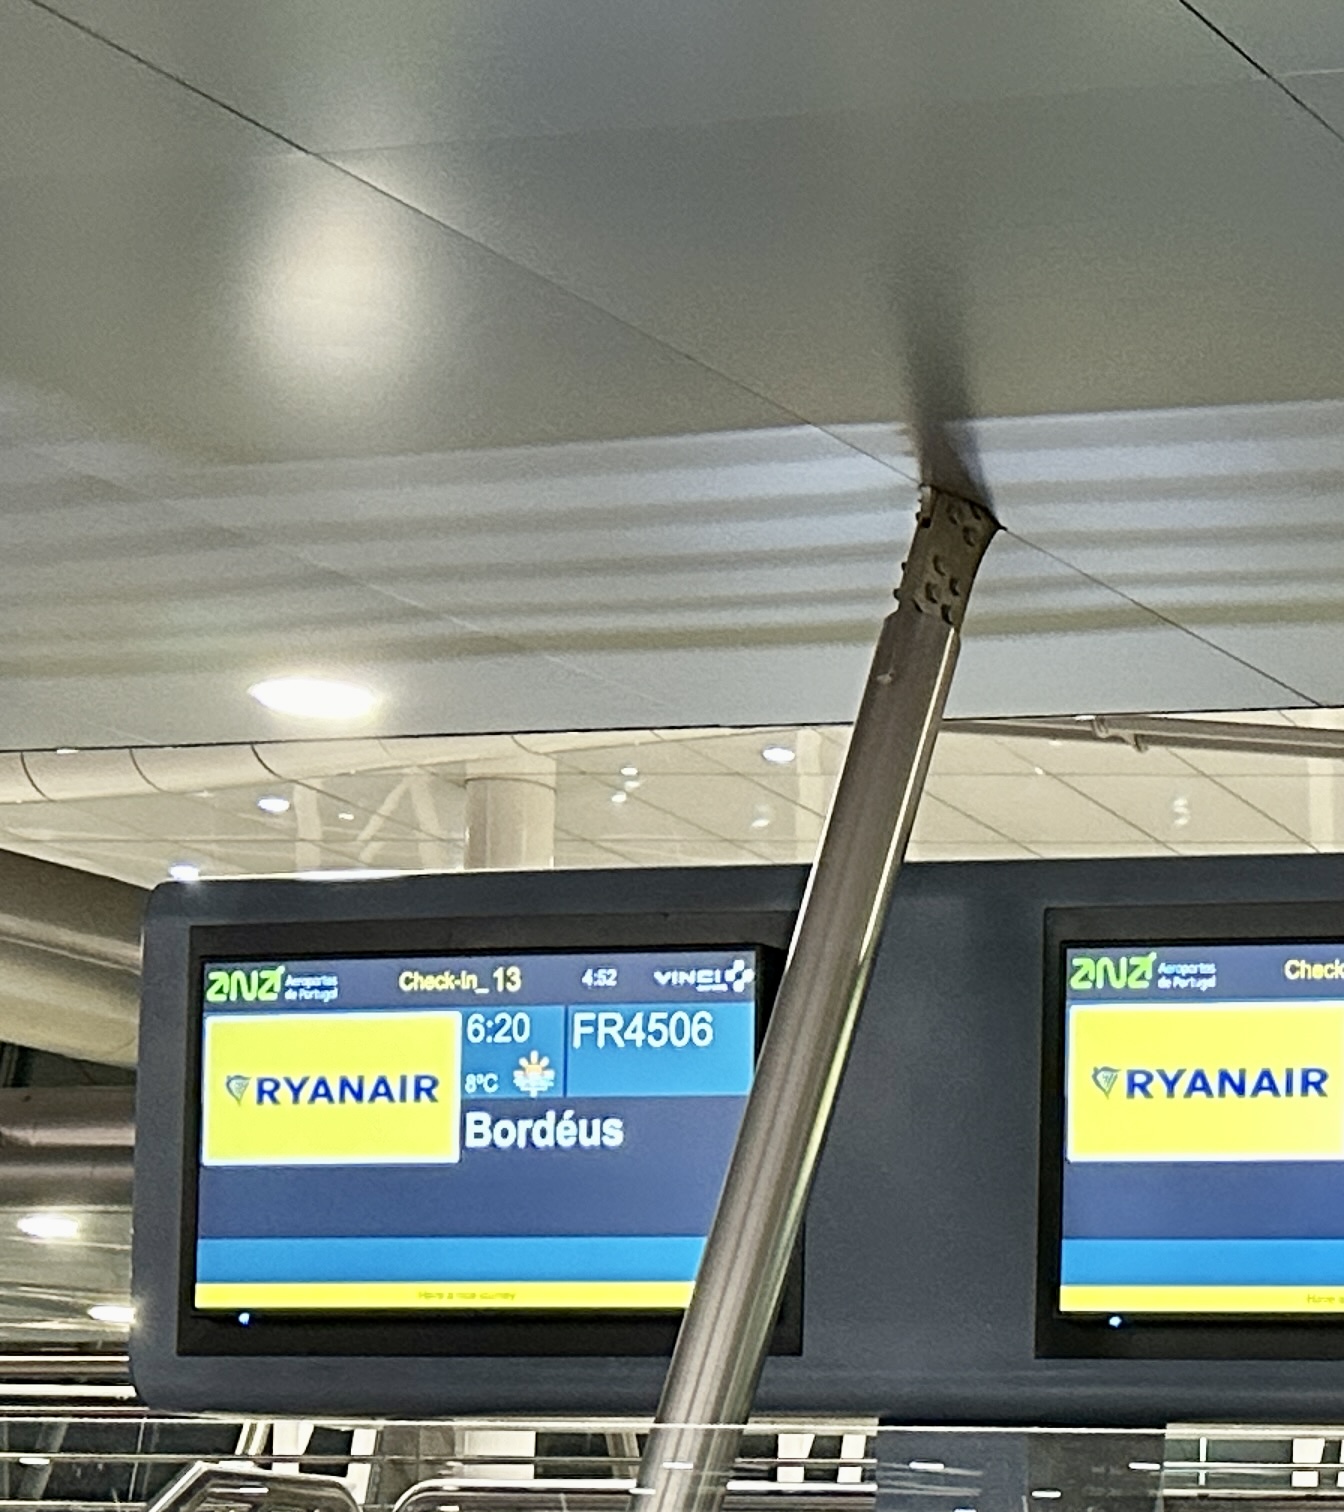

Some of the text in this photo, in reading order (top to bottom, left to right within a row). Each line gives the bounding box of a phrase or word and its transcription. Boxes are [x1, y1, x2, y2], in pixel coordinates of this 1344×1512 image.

[493, 967, 521, 992] 13
[581, 968, 618, 987] 4:52
[654, 969, 721, 985] VINCI
[466, 1012, 530, 1043] 6:20
[572, 1011, 713, 1049] FR4506
[255, 1075, 439, 1105] RYANAIR
[1125, 1066, 1329, 1098] RYANAIR
[465, 1109, 624, 1148] Bordéus
